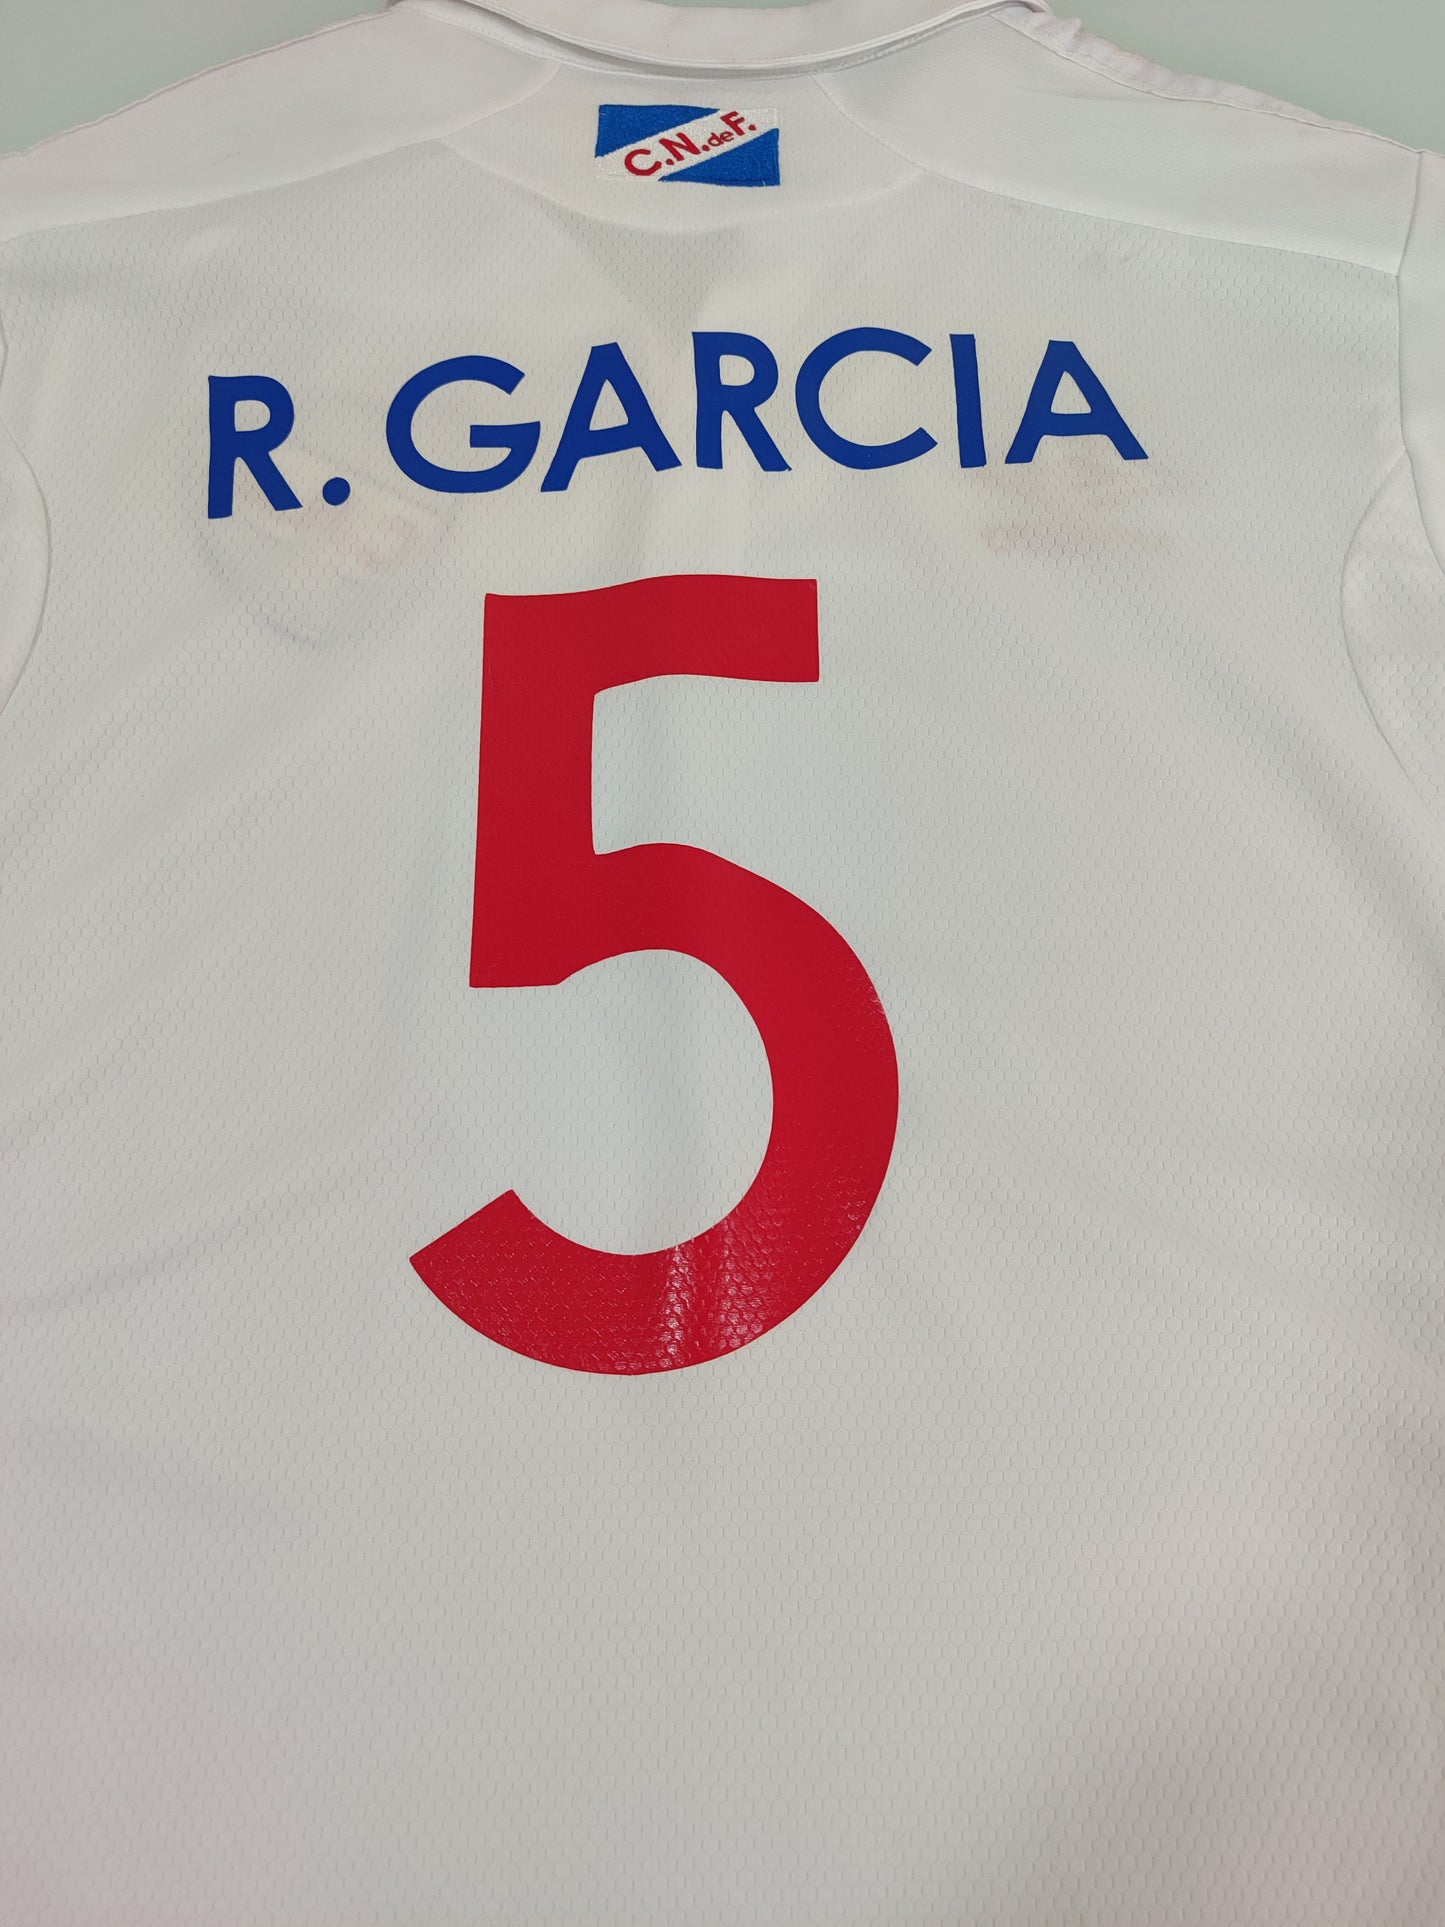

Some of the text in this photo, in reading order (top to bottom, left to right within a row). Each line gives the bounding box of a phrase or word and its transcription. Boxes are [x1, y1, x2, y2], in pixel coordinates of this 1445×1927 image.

[208, 327, 1148, 518] R. GARCIA
[410, 575, 899, 1375] 5
